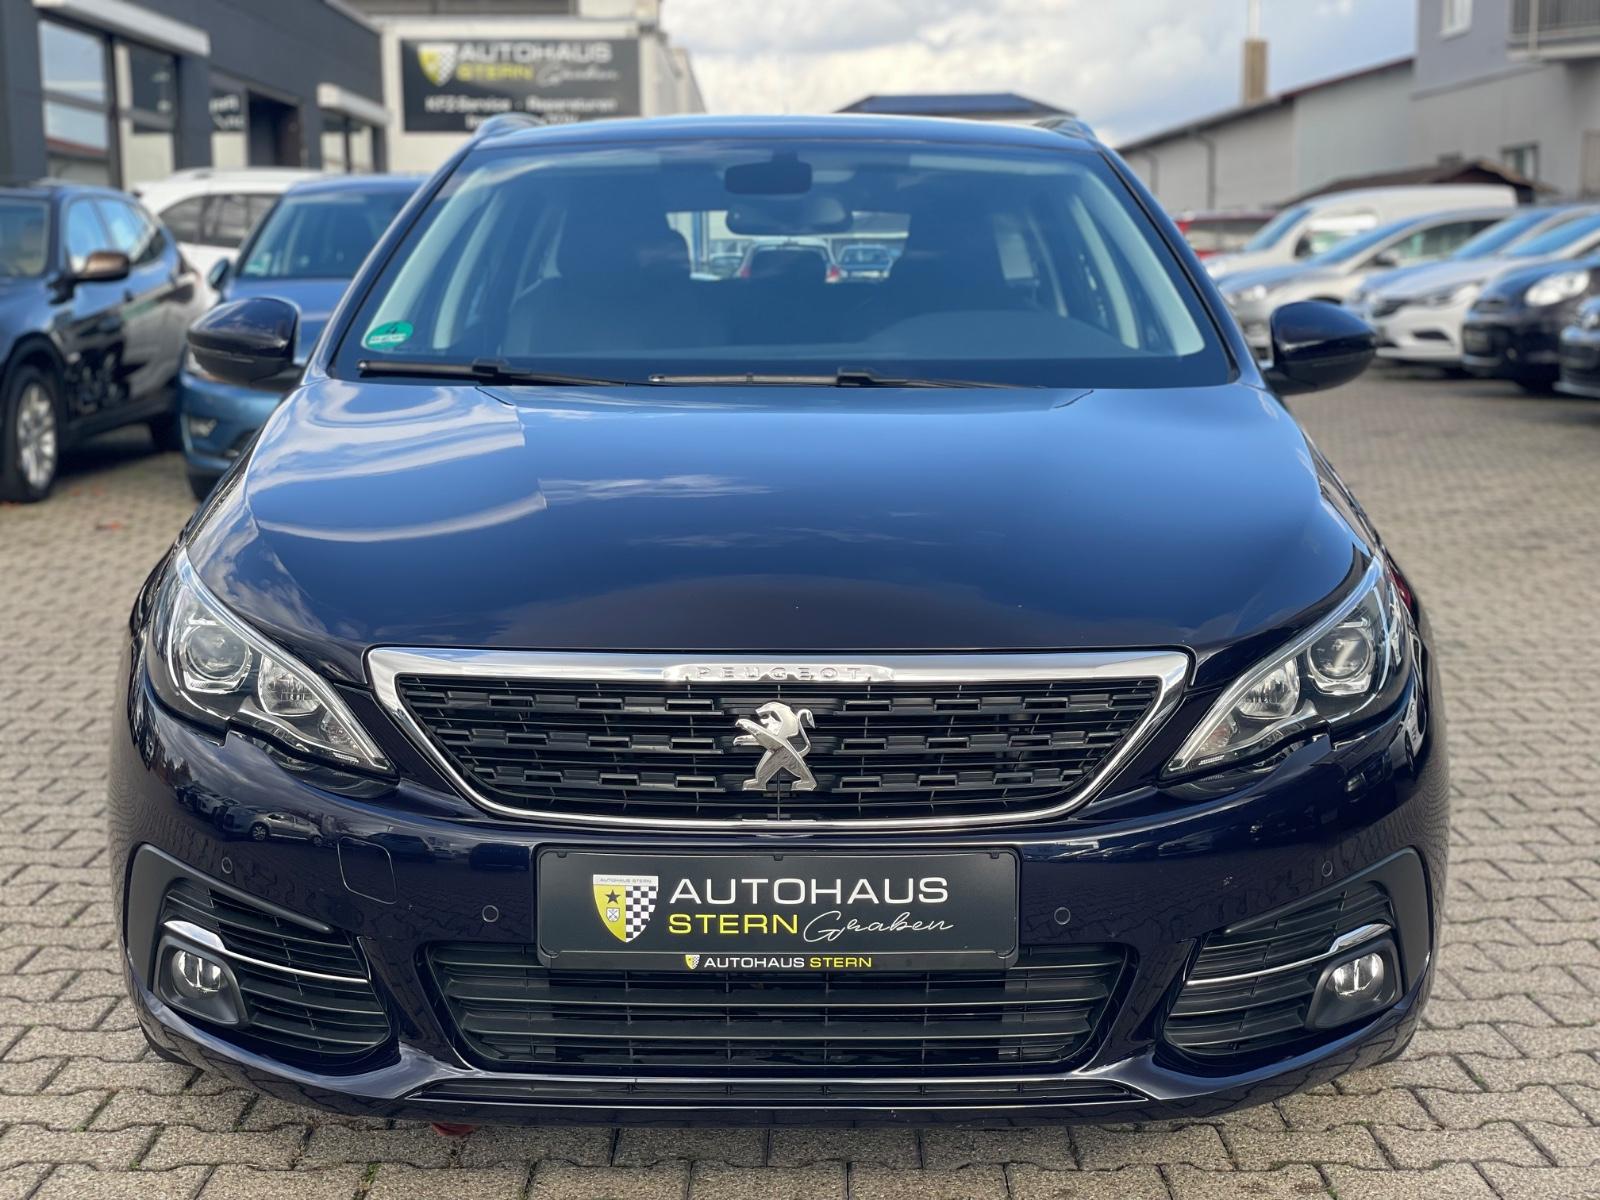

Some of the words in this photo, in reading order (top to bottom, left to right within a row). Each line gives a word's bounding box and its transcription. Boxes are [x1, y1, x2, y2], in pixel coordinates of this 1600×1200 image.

[459, 41, 612, 63] AUTOHAUS
[456, 63, 534, 81] STERN
[696, 666, 862, 680] PEUGEOT
[669, 877, 949, 905] AUTOHAUS
[668, 913, 798, 934] STERN
[803, 910, 954, 943] Graben
[704, 957, 805, 969] AUTOHAUS
[809, 957, 872, 969] STERN
